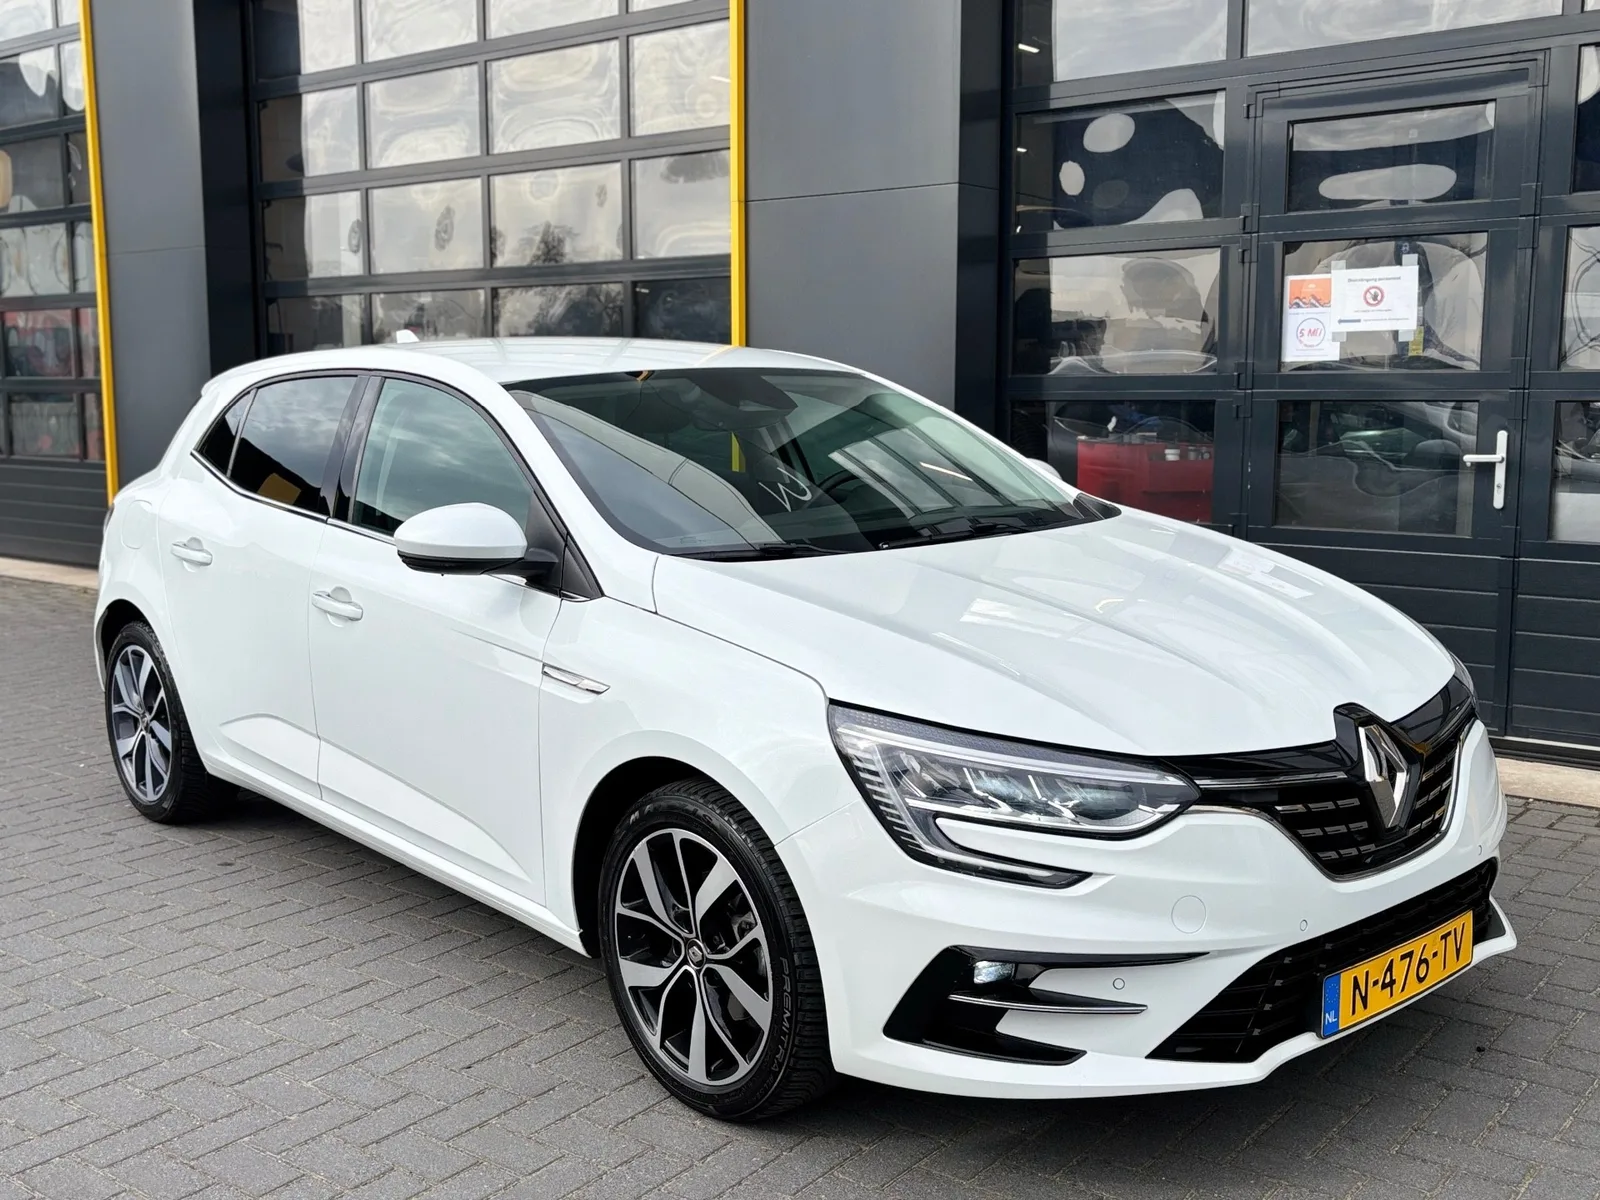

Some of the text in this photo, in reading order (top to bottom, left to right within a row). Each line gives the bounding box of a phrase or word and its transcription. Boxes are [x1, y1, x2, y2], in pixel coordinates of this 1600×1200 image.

[1299, 329, 1305, 338] 5
[1351, 922, 1466, 1017] N-476-TV
[771, 956, 792, 1072] PREMITRA
[1325, 1010, 1338, 1026] NL
